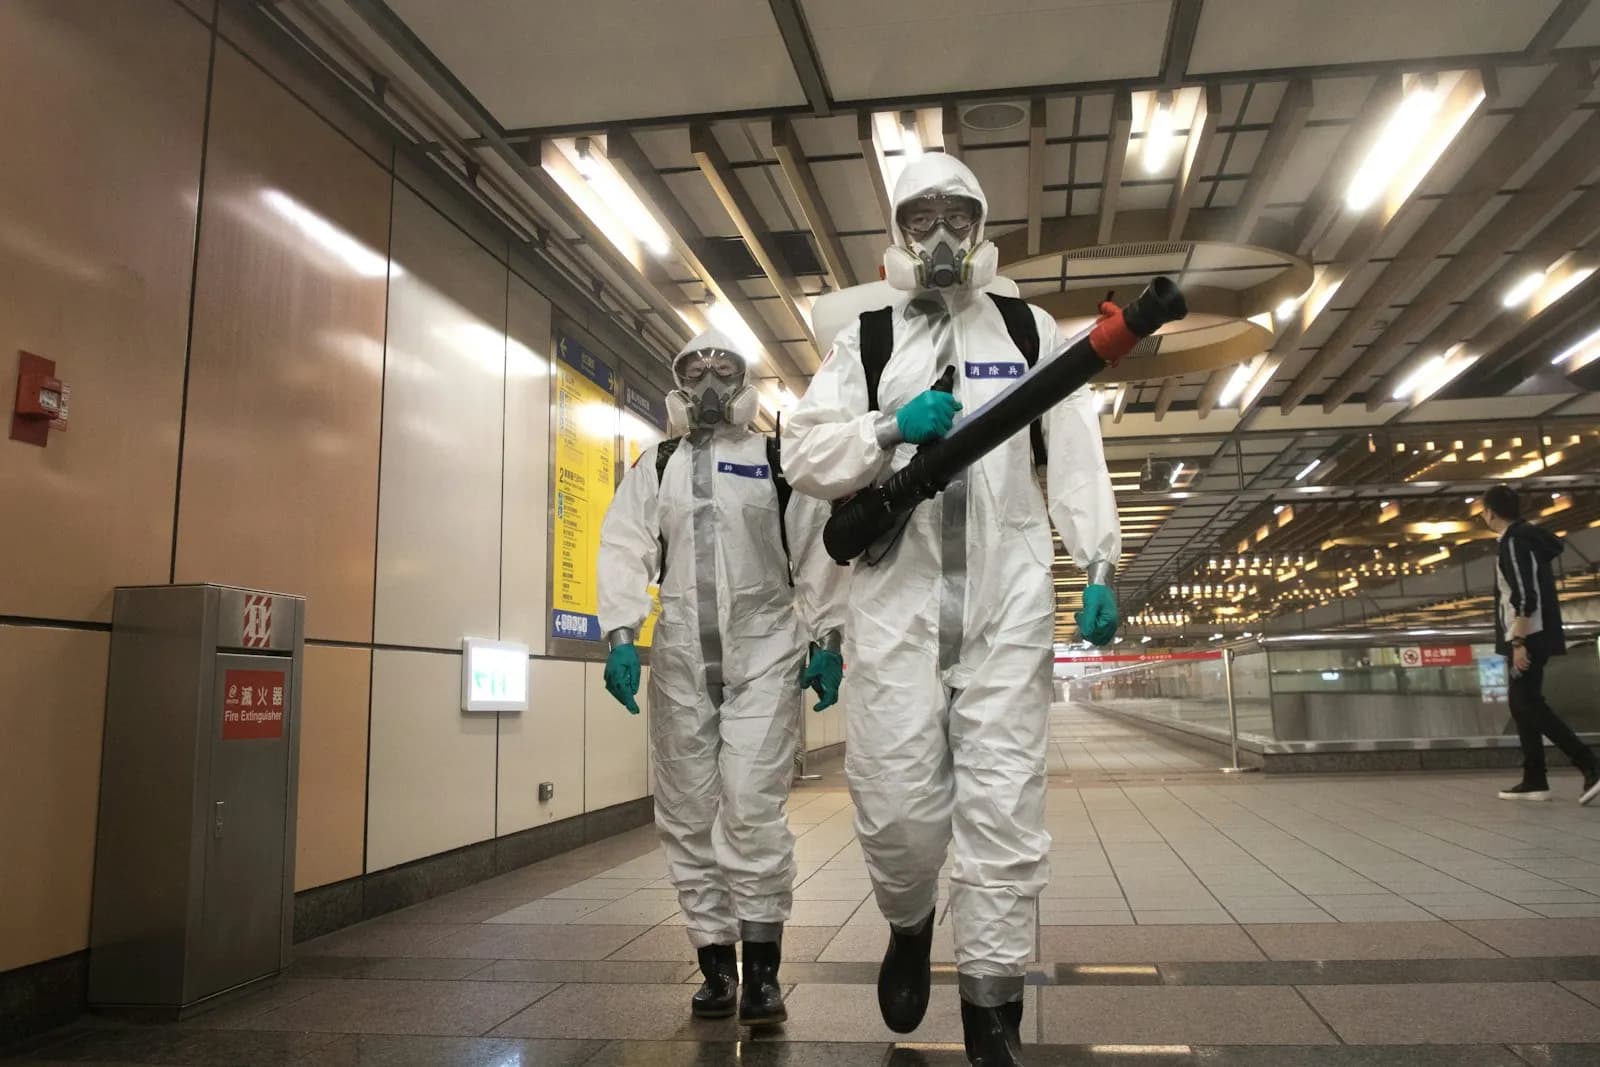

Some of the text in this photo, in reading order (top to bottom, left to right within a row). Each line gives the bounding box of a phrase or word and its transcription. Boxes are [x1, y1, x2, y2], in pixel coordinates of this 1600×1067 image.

[970, 365, 1018, 376] 消除兵
[241, 686, 282, 706] 滅火器
[224, 710, 282, 723] Fire Extinguisher
